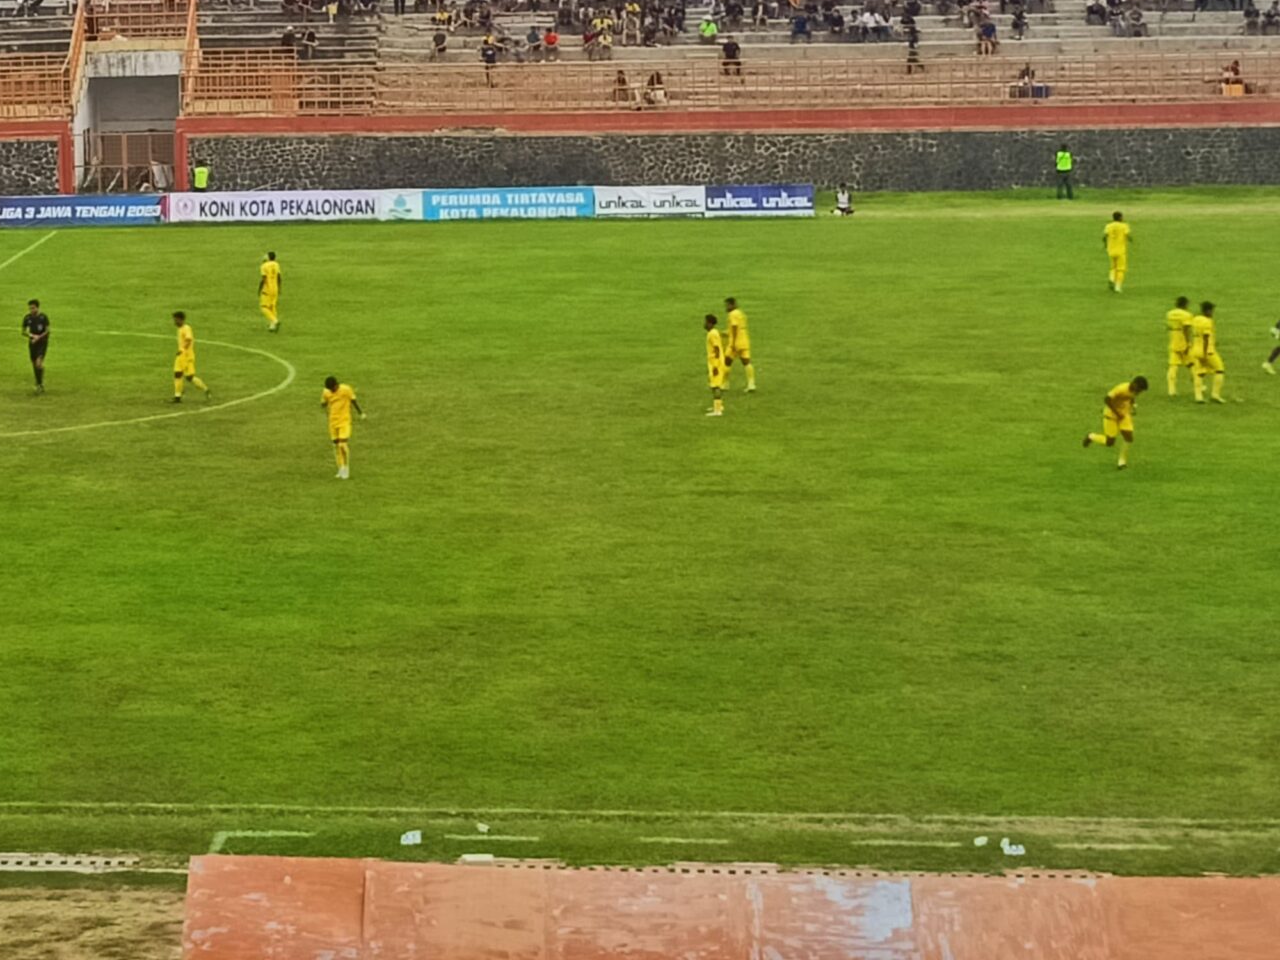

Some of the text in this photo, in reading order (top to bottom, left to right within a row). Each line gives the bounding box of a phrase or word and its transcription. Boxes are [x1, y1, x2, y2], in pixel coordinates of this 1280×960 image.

[431, 192, 584, 206] PERUMDA TIRTAYASA
[24, 207, 35, 219] 3
[36, 206, 72, 219] JAWA
[75, 205, 125, 218] TENGAH
[199, 199, 376, 217] KONI KOTA PEKALONGAN
[439, 208, 477, 219] KOTA
